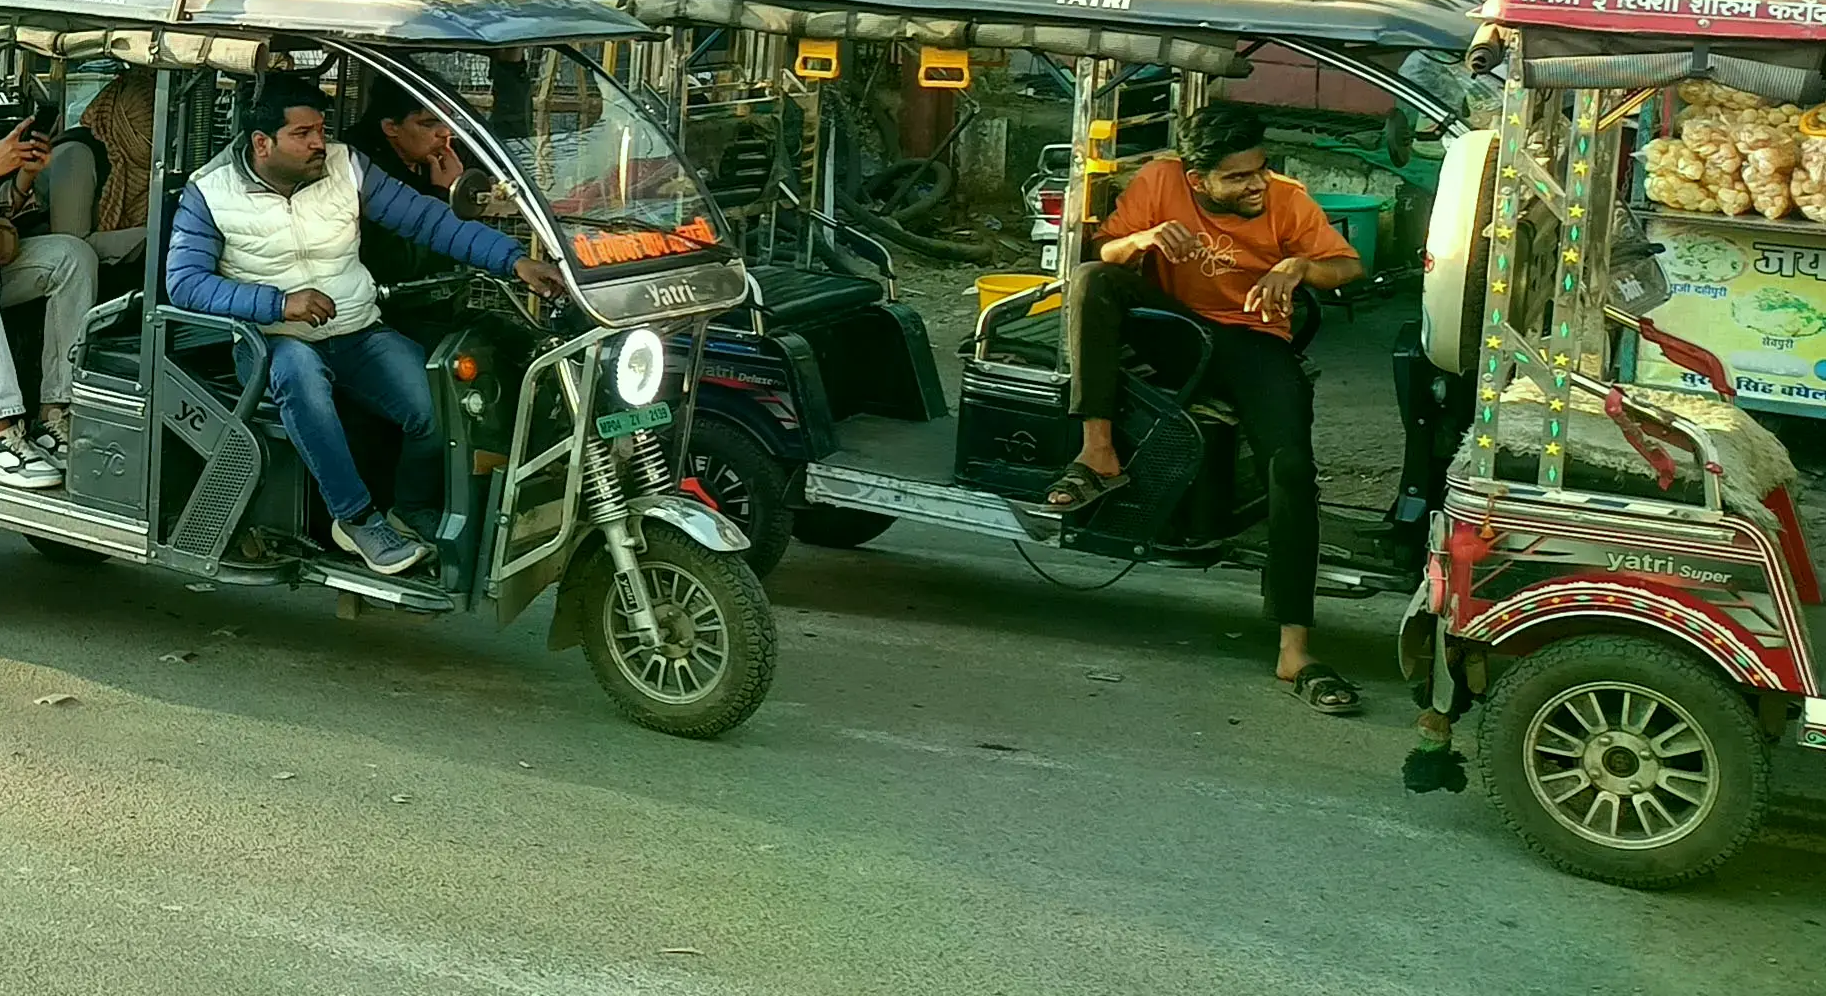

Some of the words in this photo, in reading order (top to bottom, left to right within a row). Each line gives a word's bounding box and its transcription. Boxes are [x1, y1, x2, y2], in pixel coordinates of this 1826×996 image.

[648, 279, 695, 307] Yatri
[1606, 547, 1675, 577] yatri
[1678, 564, 1732, 585] Super
